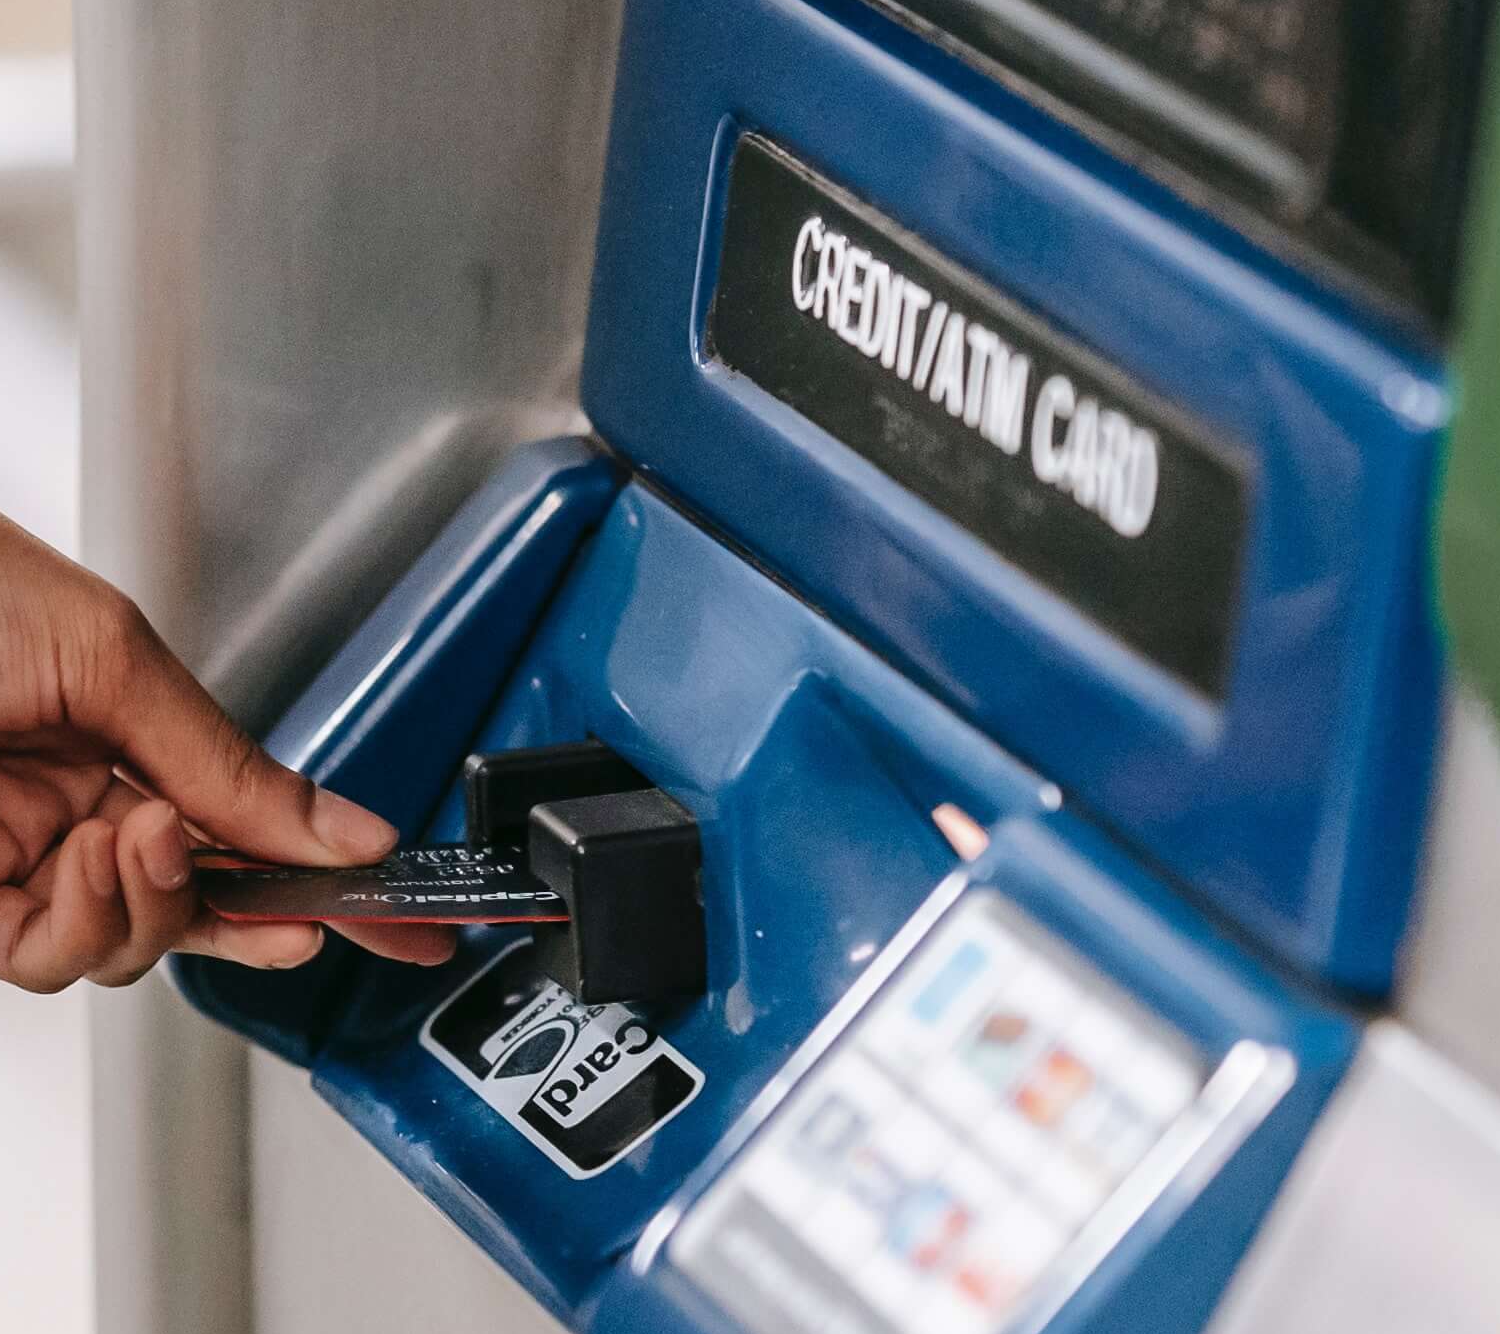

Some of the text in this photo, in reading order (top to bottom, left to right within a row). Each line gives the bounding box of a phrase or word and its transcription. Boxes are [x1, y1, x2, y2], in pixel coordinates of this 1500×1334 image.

[793, 216, 1160, 538] CREDIT/ATM CARD
[540, 1017, 659, 1118] Card
